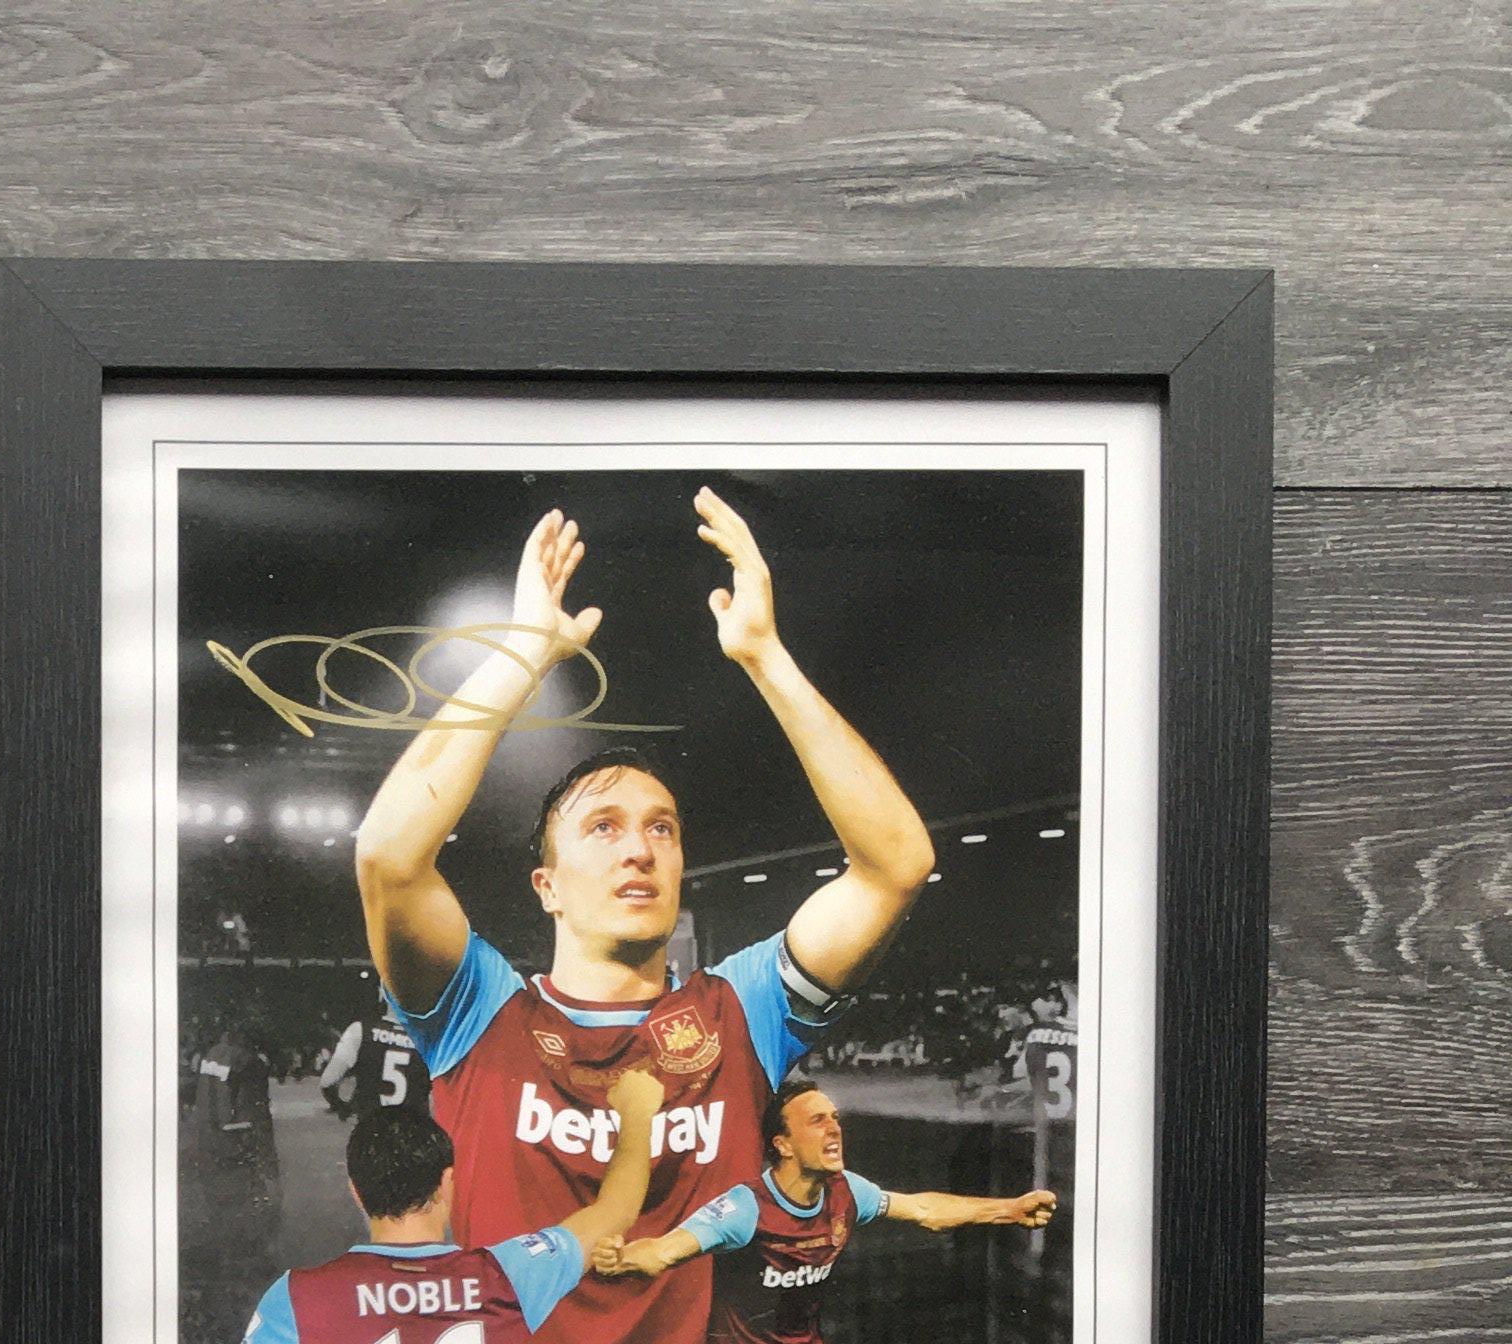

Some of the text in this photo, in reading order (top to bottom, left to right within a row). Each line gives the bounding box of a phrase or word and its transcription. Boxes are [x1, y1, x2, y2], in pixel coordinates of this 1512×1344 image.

[379, 1050, 410, 1106] 5
[1044, 1052, 1073, 1119] 3
[356, 1278, 482, 1317] NOBLE
